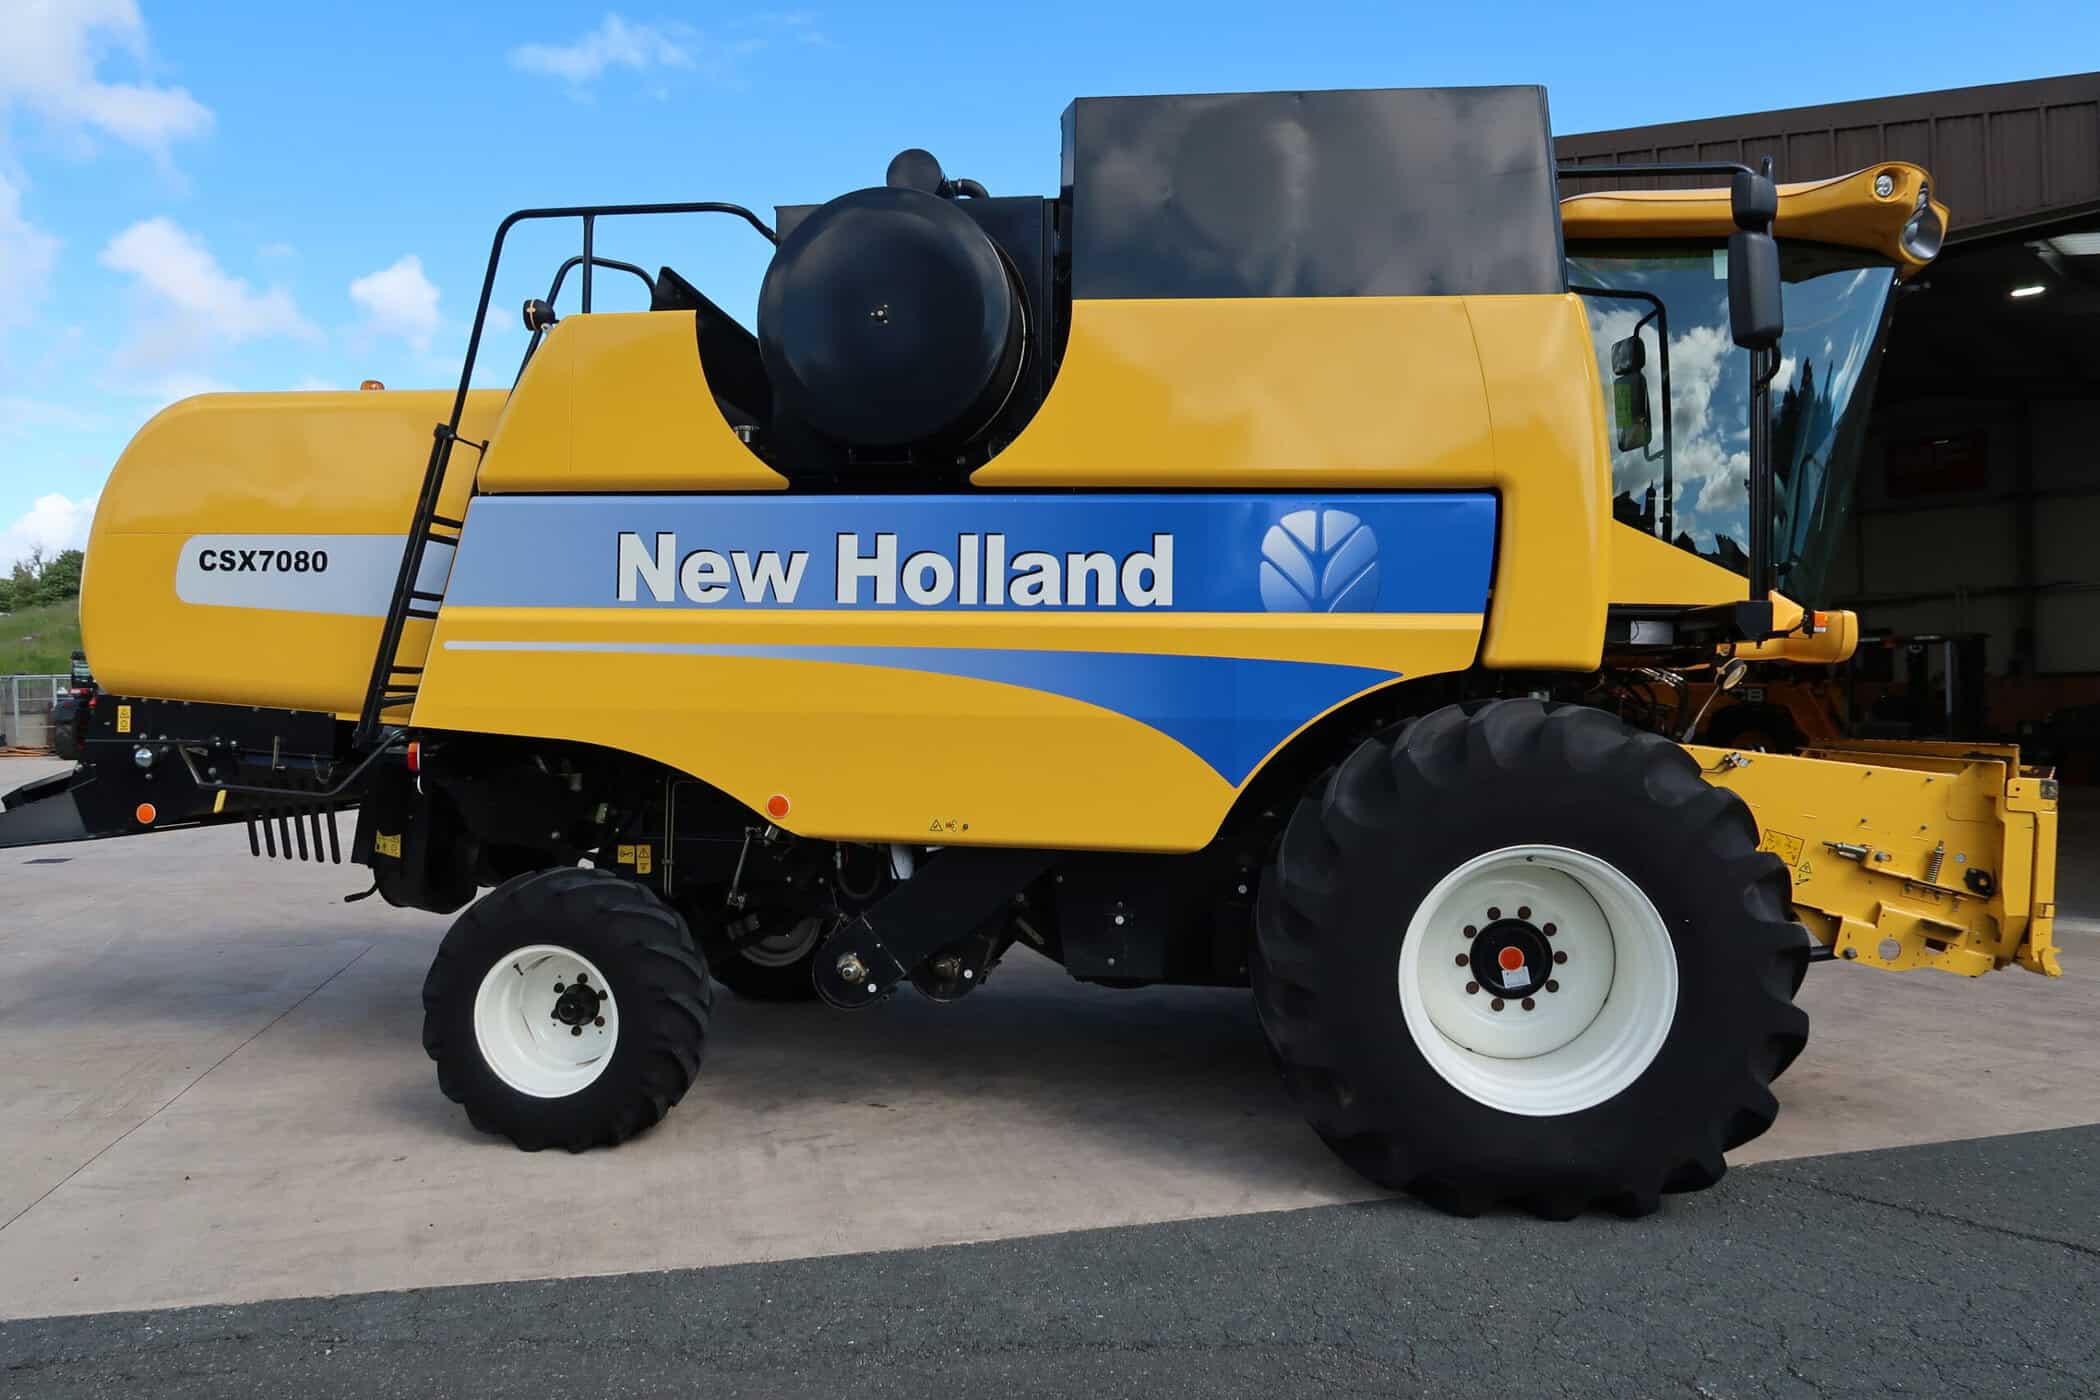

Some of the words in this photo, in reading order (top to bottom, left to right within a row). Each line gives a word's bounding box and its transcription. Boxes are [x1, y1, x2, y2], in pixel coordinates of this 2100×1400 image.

[199, 549, 328, 573] CSX7080
[616, 531, 809, 604] New
[835, 532, 1174, 608] Holland
